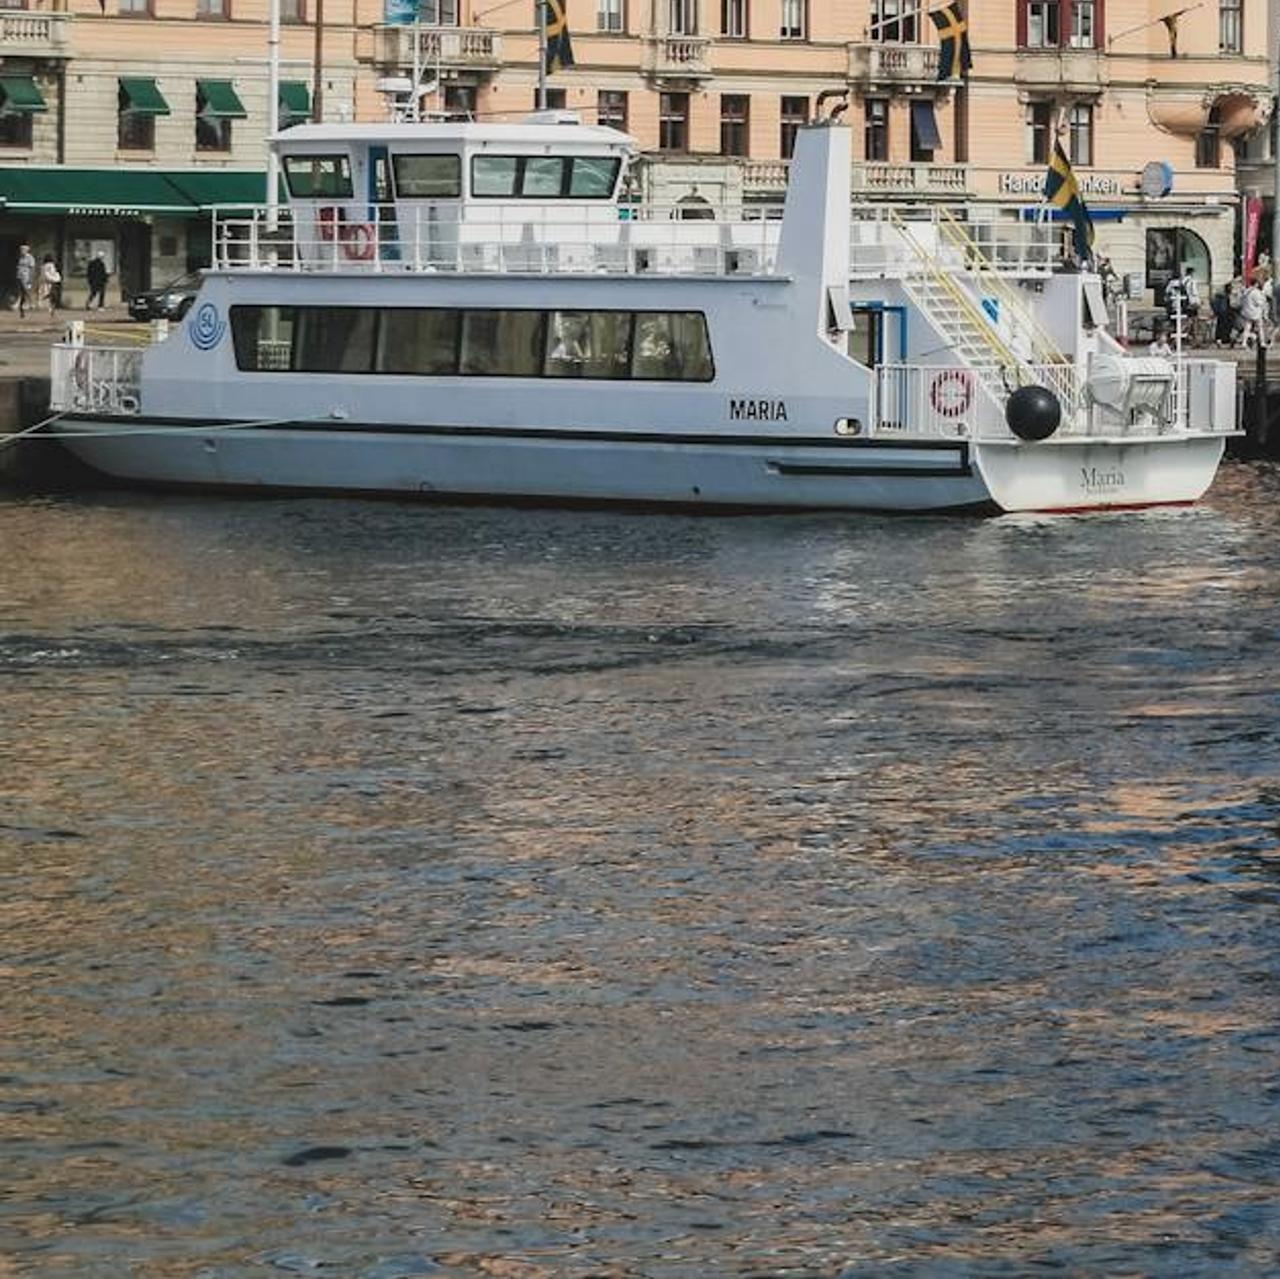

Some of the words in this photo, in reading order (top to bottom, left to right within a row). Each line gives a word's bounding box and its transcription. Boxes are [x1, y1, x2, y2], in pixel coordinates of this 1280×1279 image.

[1001, 174, 1122, 195] Handanken
[730, 400, 787, 421] MARIA
[1080, 467, 1124, 487] Maria
